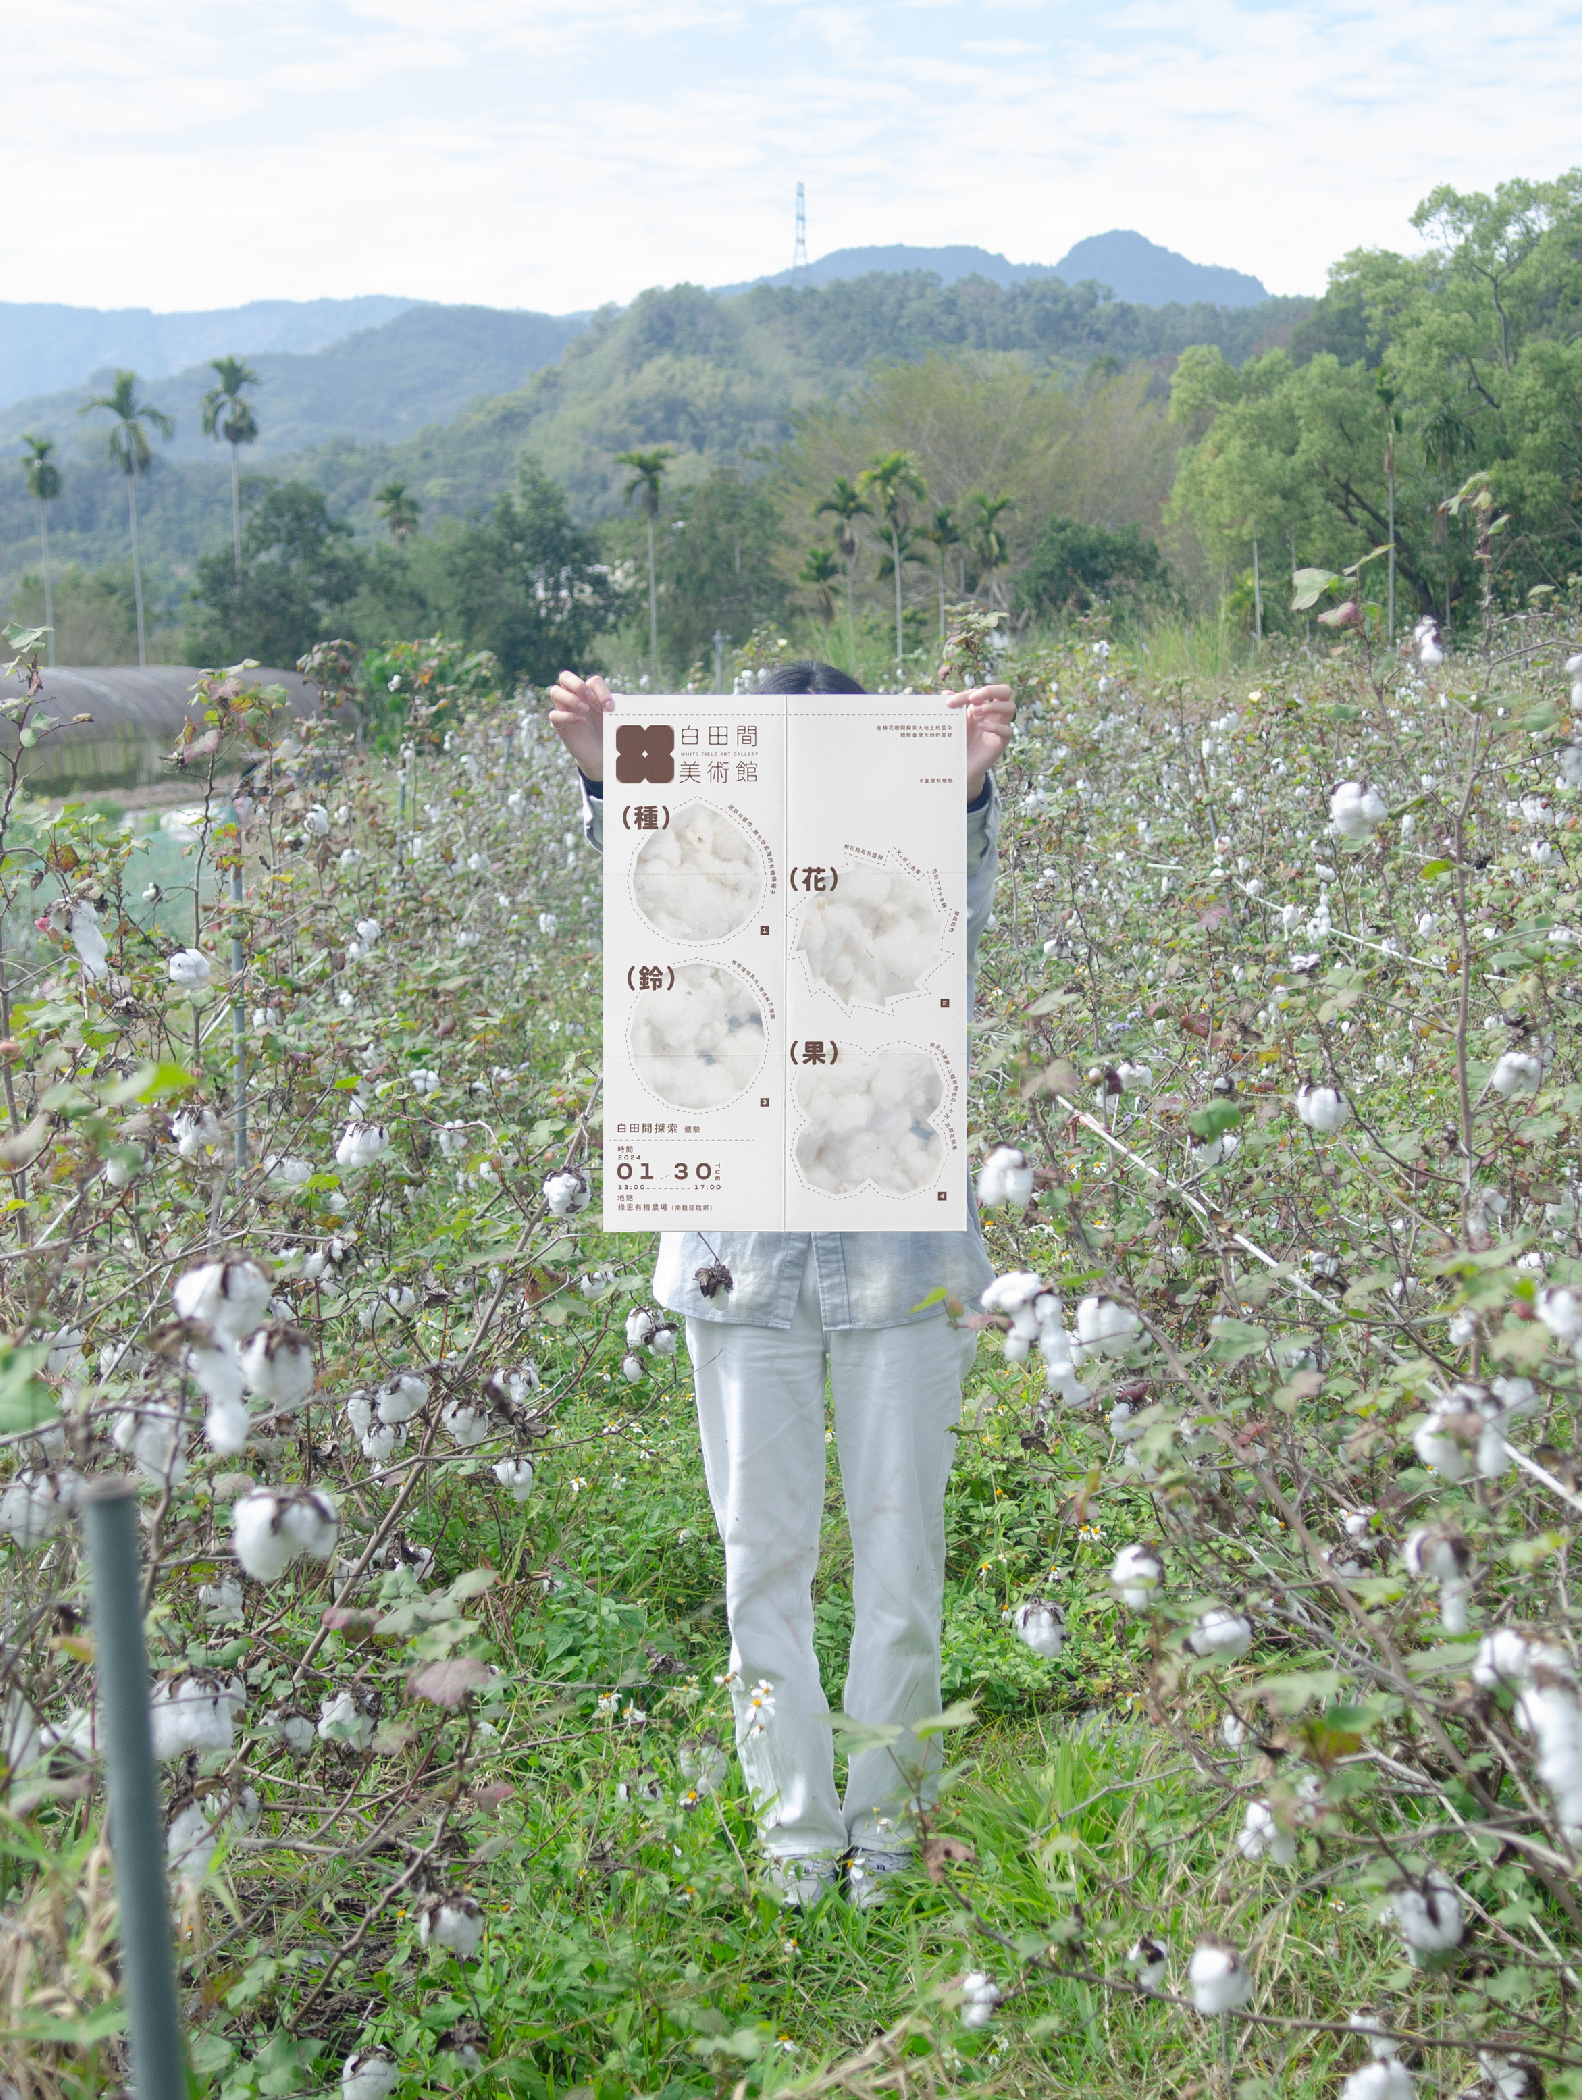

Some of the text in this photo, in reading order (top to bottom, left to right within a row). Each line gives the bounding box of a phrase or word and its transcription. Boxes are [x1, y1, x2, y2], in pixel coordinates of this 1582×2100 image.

[681, 725, 757, 746] 白田間
[679, 760, 758, 784] 美術館
[622, 805, 670, 830] (種)
[790, 866, 839, 892] (花)
[627, 965, 675, 991] (鈴)
[790, 1040, 839, 1065] (果)
[617, 1122, 678, 1134] 白田間探索
[617, 1145, 634, 1153] 時間
[616, 1162, 712, 1180] 01 30
[617, 1194, 634, 1202] 地點
